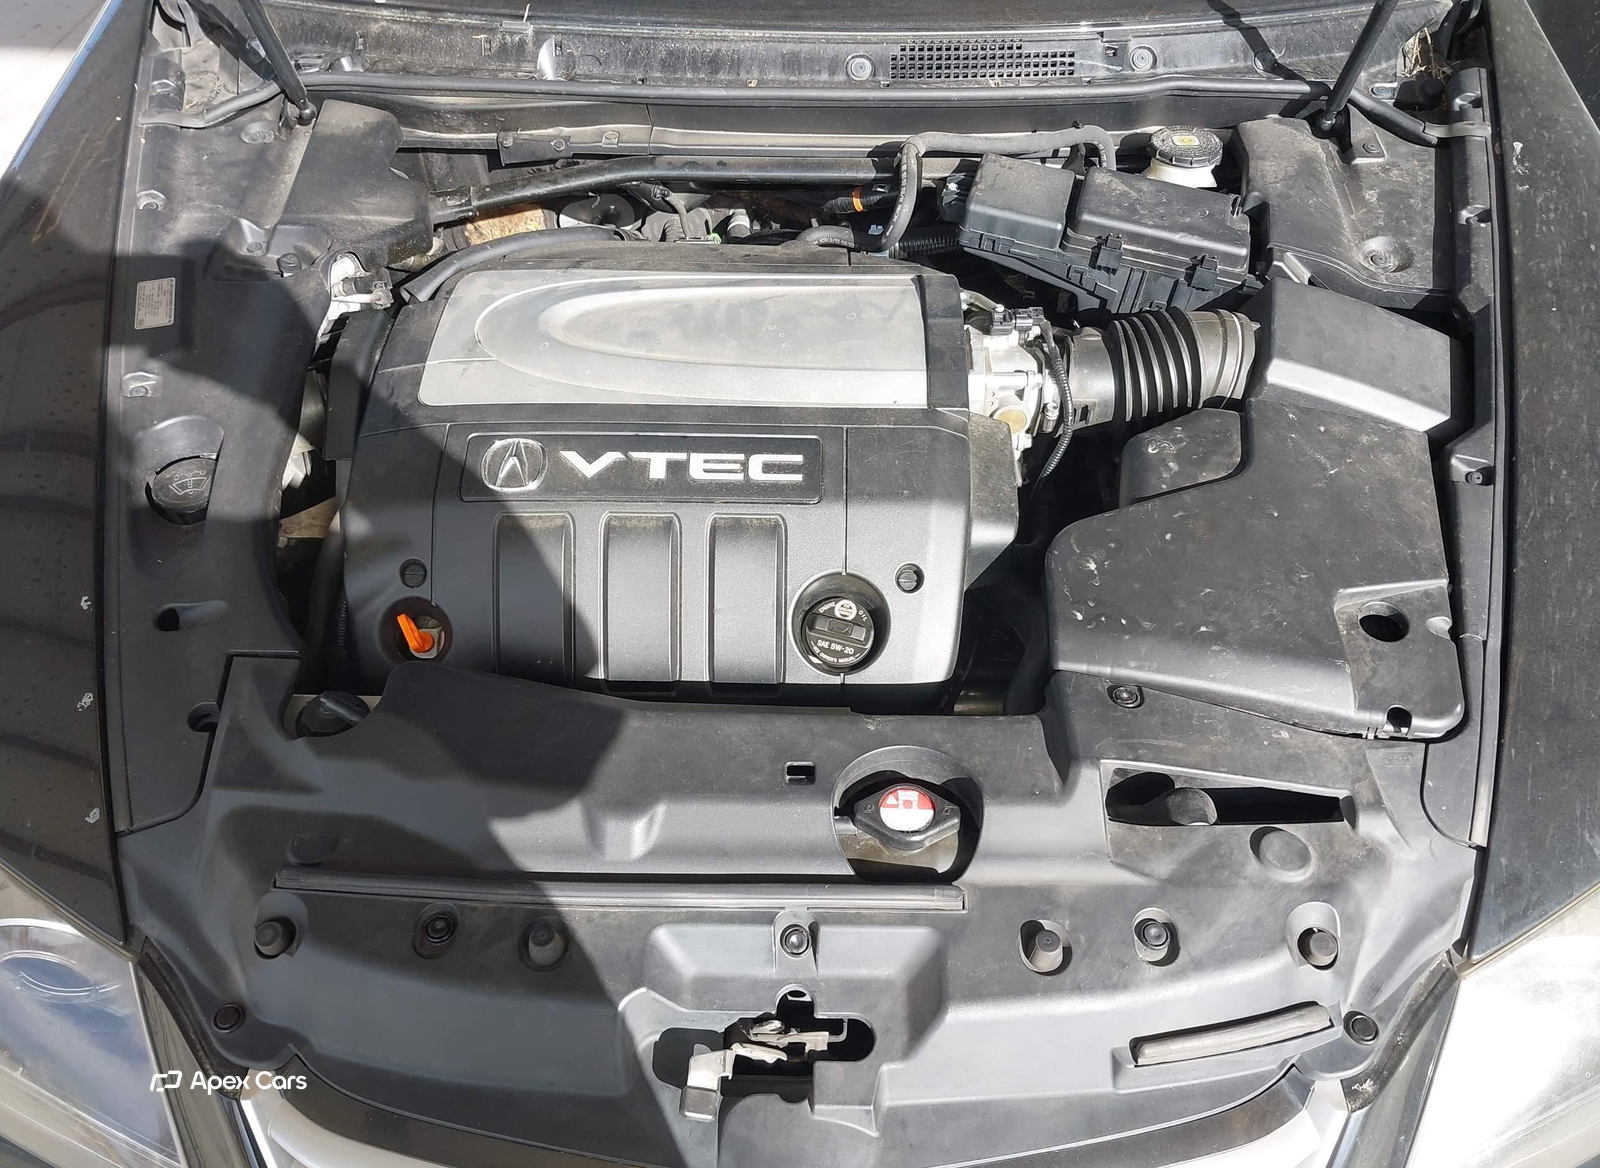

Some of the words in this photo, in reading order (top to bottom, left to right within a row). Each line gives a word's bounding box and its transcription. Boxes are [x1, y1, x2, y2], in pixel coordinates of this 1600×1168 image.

[559, 451, 804, 481] VTEC
[818, 601, 836, 613] ENGINE
[858, 610, 868, 622] OIL
[816, 639, 830, 649] SAE
[830, 643, 855, 655] 5W-20
